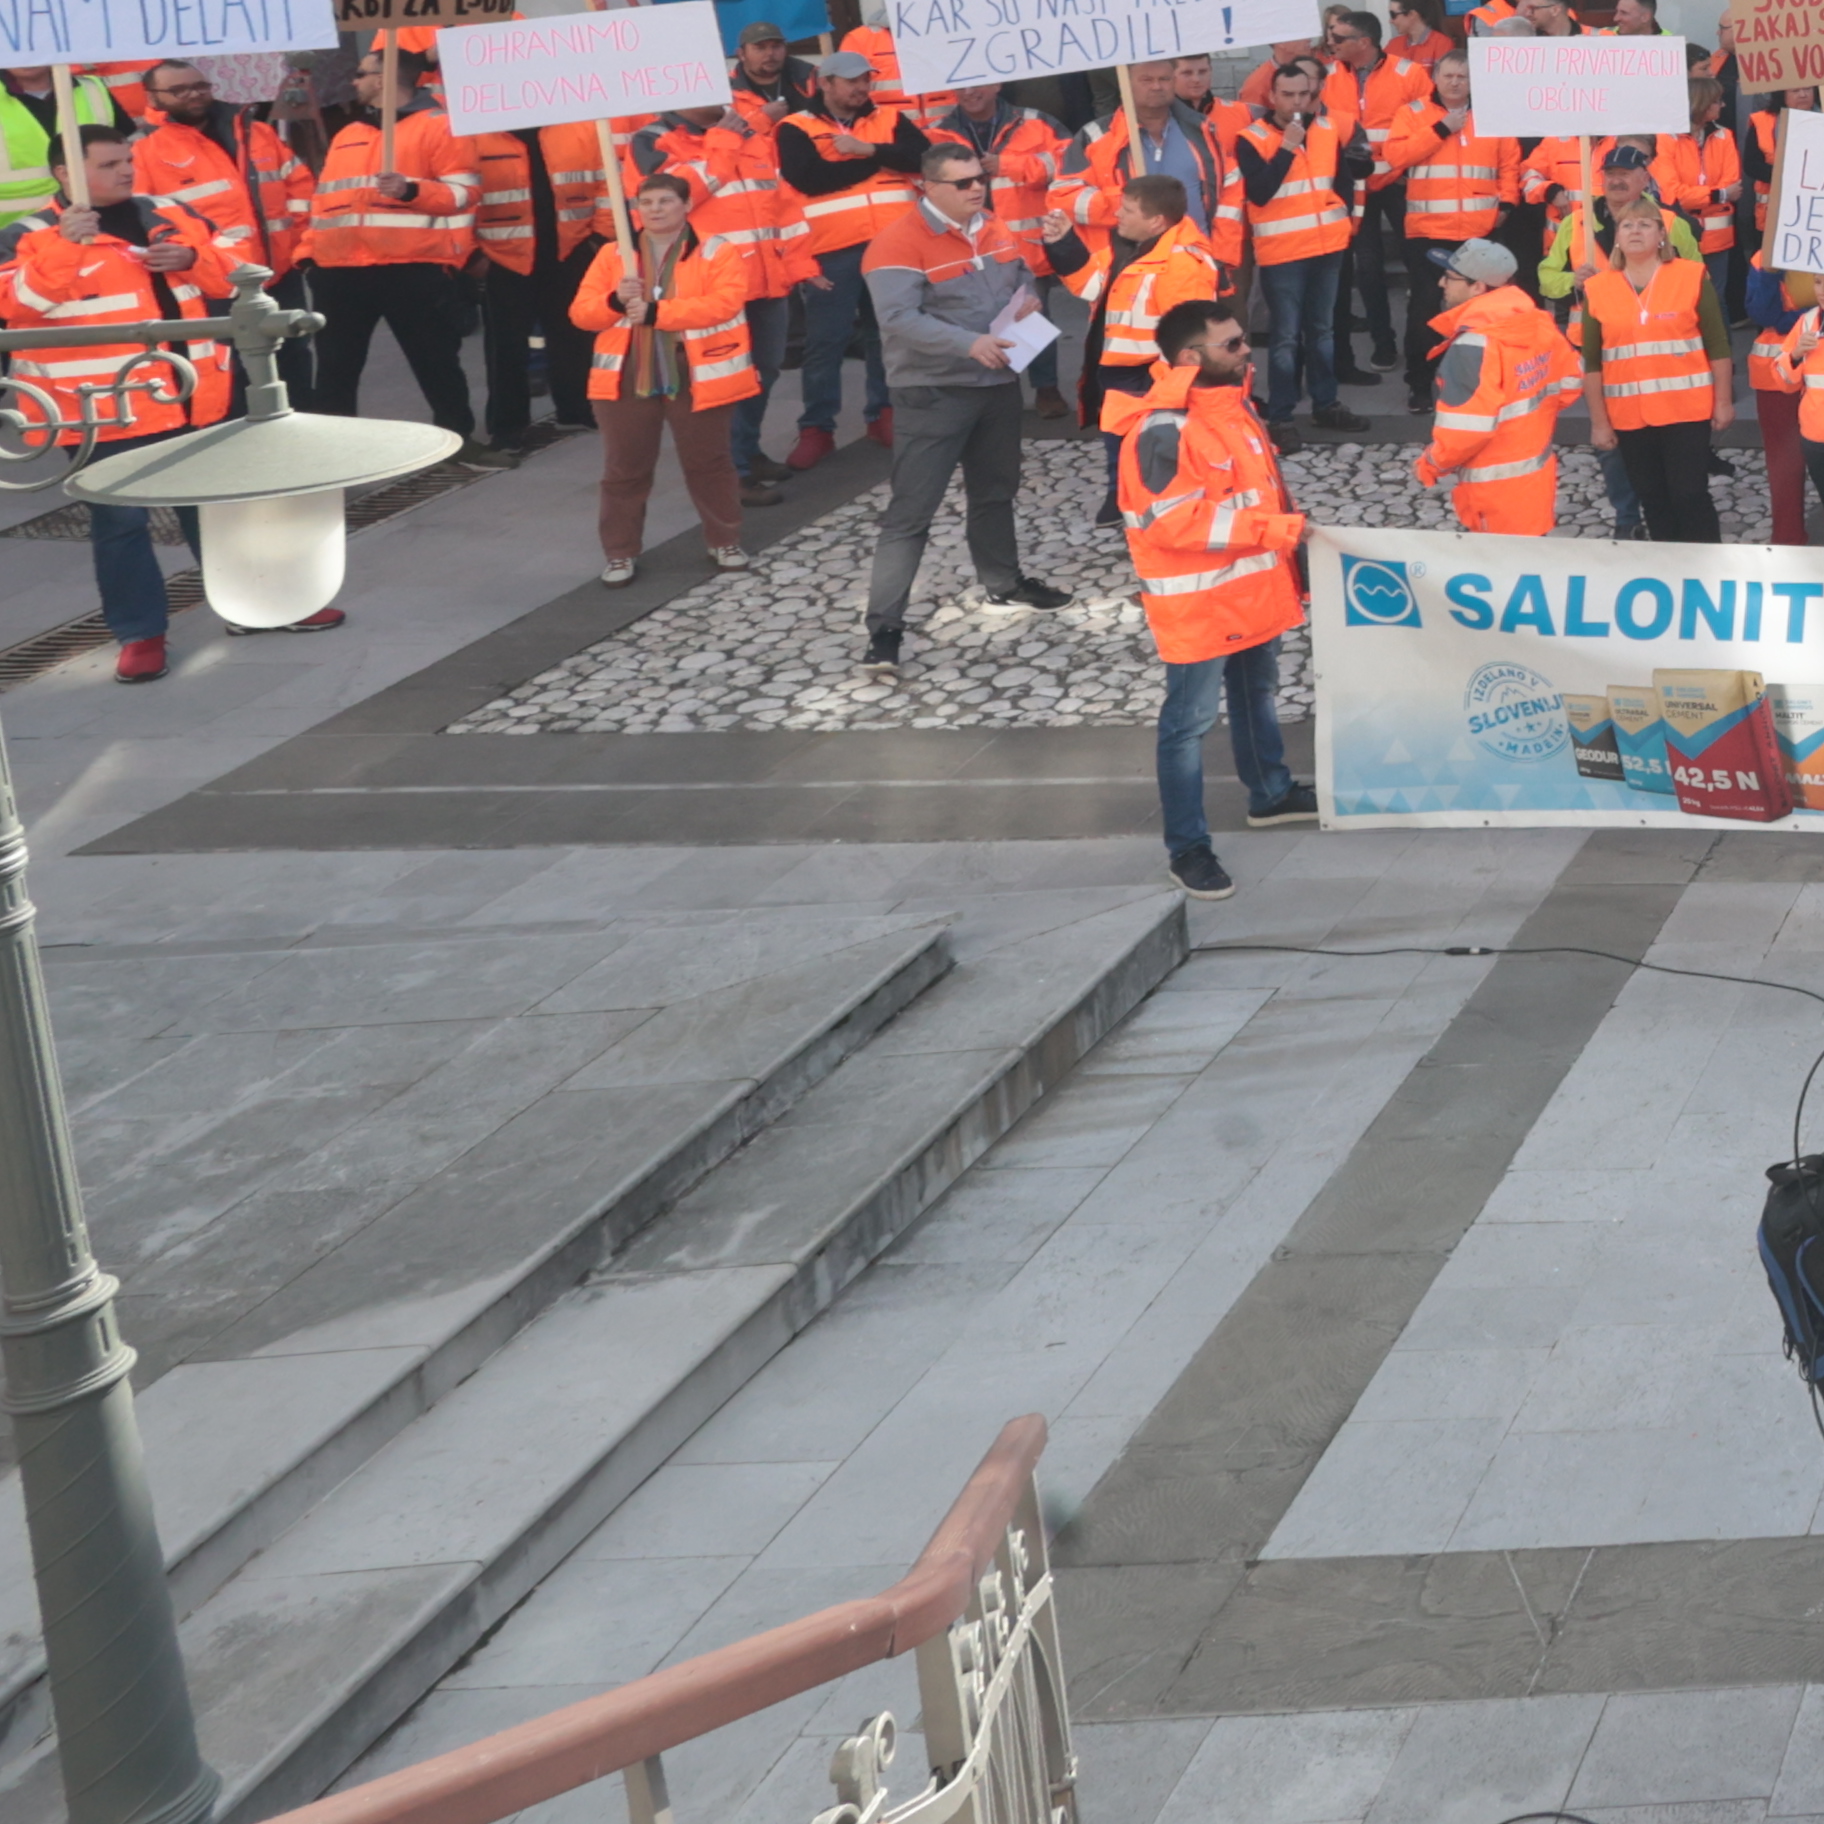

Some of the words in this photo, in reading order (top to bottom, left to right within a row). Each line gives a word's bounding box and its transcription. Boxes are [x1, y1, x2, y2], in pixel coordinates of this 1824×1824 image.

[465, 19, 640, 67] OHRANIMO
[1734, 10, 1811, 44] ZAKAJ
[945, 9, 1182, 83] ZGRADILI
[1487, 46, 1546, 74] PROTI
[1555, 47, 1680, 76] PRIVATIZACIJI
[1738, 48, 1784, 83] VAS
[461, 72, 609, 113] DELOVNA
[621, 61, 714, 97] MESTA
[1527, 82, 1610, 112] OBČINE
[1444, 572, 1824, 643] SALONIT
[1472, 668, 1526, 702] IZDELANO
[1664, 700, 1718, 712] UNIVERSAL
[1665, 710, 1704, 720] CEMENT
[1574, 747, 1619, 765] GEODUR
[1673, 766, 1733, 793] 42,5
[1735, 770, 1761, 791] N
